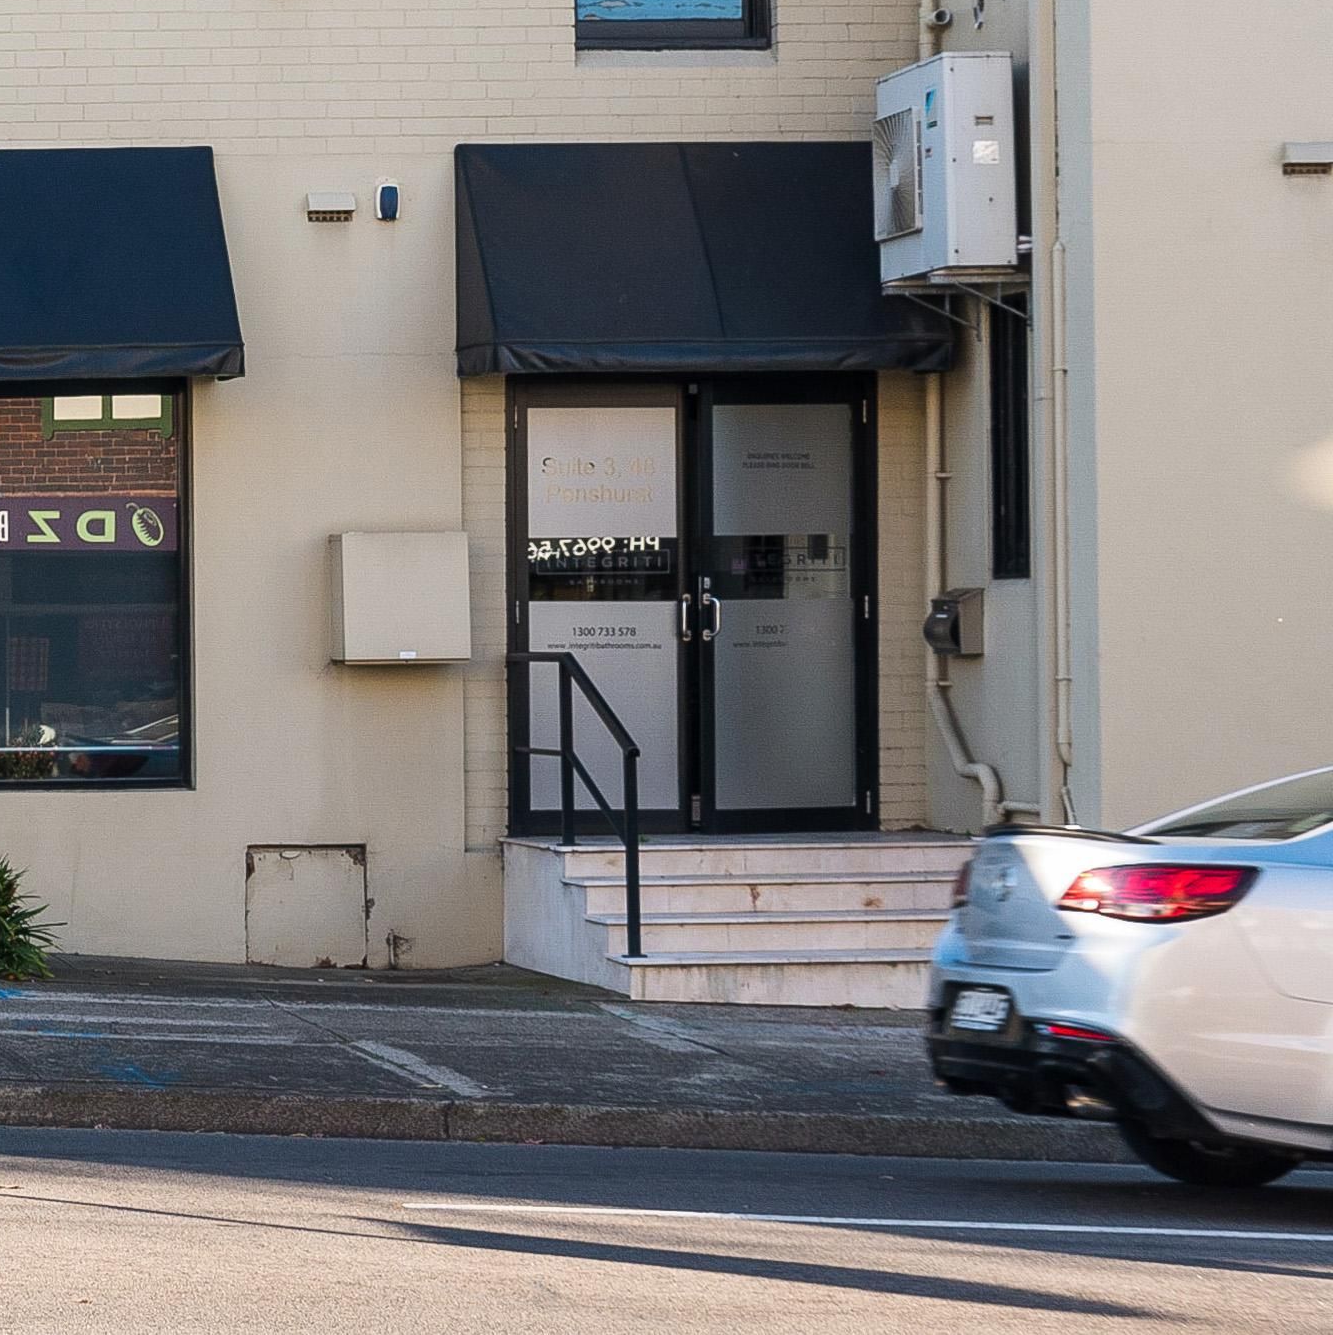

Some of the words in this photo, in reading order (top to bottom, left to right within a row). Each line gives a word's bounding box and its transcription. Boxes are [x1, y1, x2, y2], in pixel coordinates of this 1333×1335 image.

[546, 556, 662, 569] INTEGRITI
[572, 626, 596, 637] 1300
[598, 626, 616, 637] 733
[618, 626, 637, 637] 578
